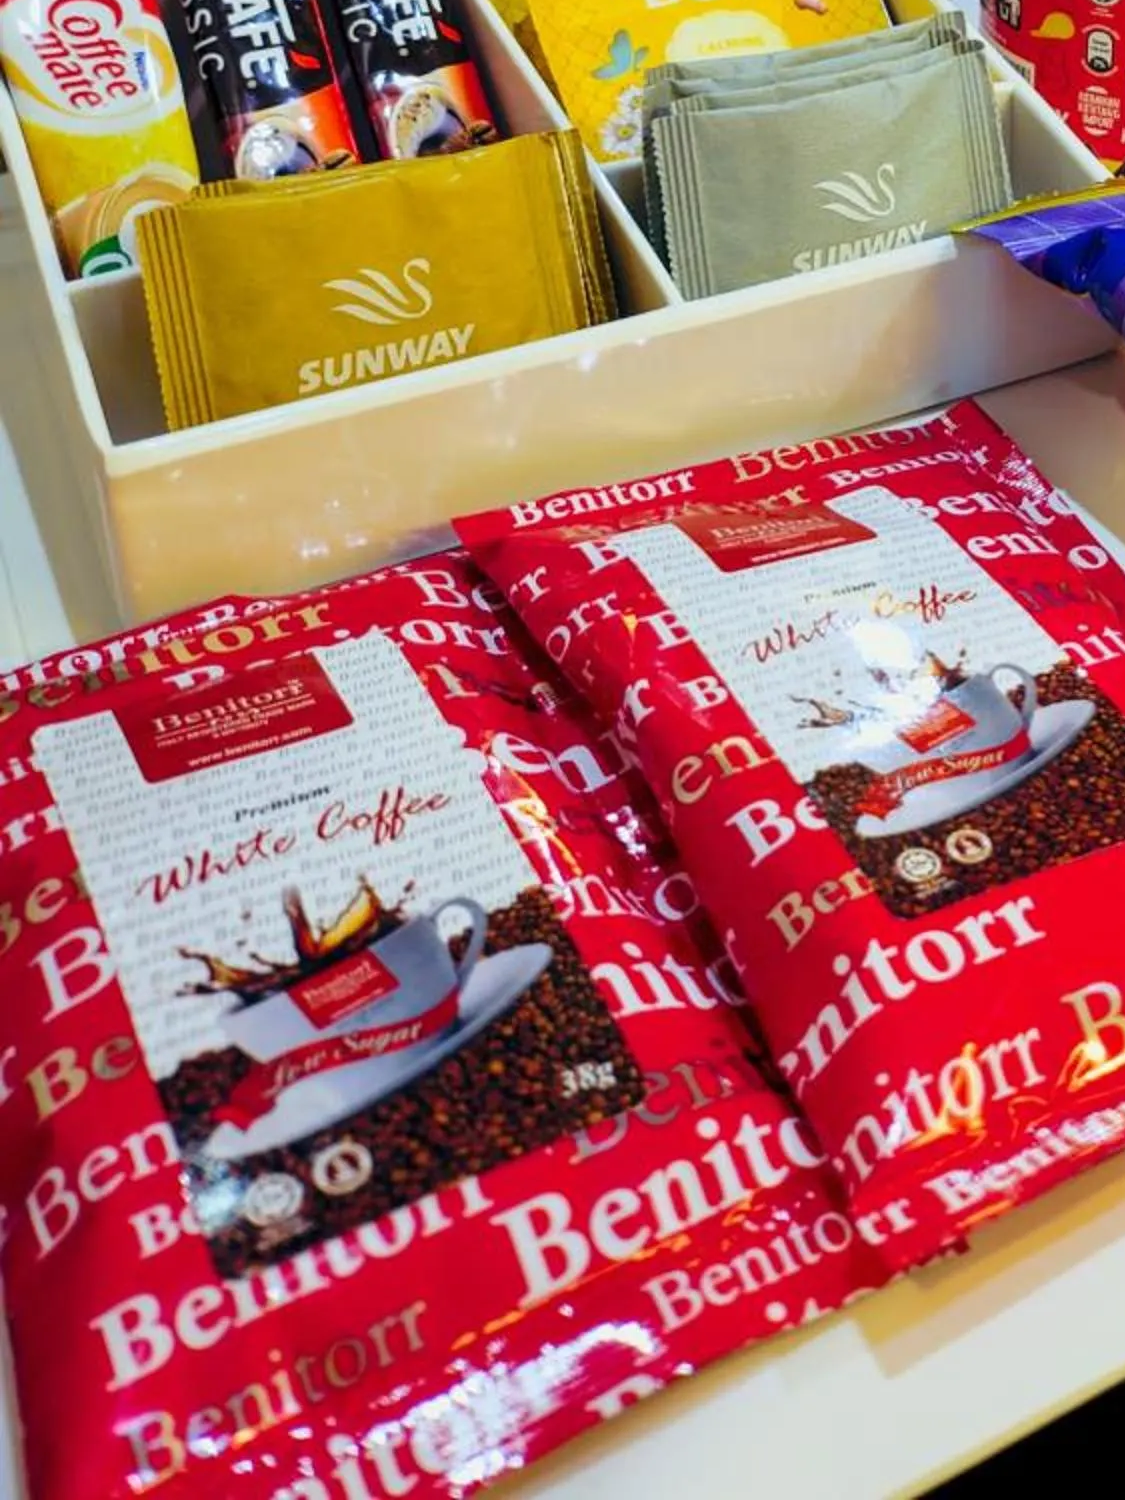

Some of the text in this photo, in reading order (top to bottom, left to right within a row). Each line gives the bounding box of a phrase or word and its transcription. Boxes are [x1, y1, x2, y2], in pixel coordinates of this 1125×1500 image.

[793, 220, 928, 272] SUNWAY
[299, 323, 476, 394] SUNWAY
[509, 468, 697, 528] Benitorr
[151, 680, 304, 734] Benitorr
[234, 784, 331, 823] Premium
[134, 827, 298, 904] White
[316, 785, 453, 847] Coffee
[332, 1020, 424, 1062] Sugar
[560, 1061, 618, 1098] 38g
[832, 1024, 1047, 1186] nitorr
[89, 1174, 495, 1393] Benitorr
[112, 1298, 428, 1497] Benitorr
